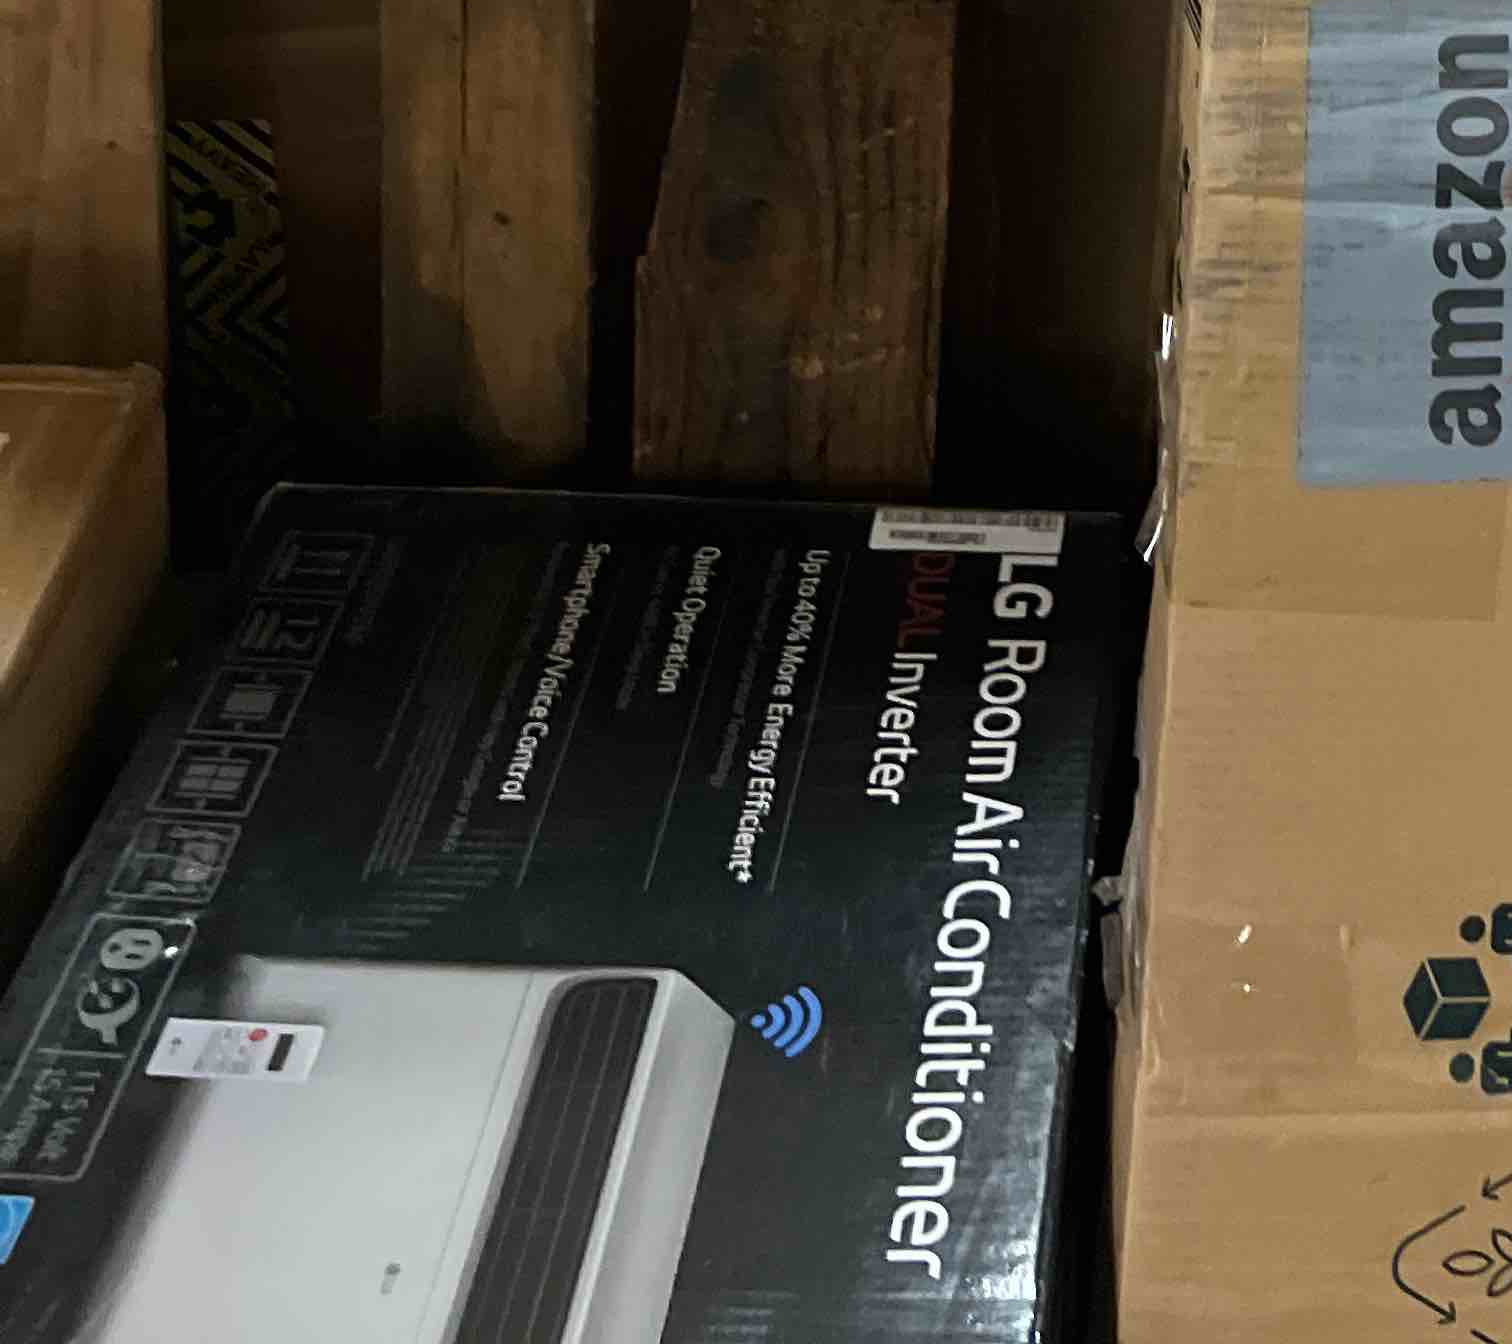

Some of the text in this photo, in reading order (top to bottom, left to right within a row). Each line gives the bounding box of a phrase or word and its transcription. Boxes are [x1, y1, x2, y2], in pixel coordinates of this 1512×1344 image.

[1428, 33, 1510, 448] amazon
[798, 548, 832, 578] Up
[897, 552, 956, 649] DUAL
[528, 543, 612, 720] Smartphone/Voice
[656, 545, 722, 695] Quiet Operation
[787, 602, 817, 641] 40%
[769, 644, 808, 698] More
[497, 721, 550, 802] Control
[747, 703, 795, 775] Energy
[866, 652, 938, 805] Inverter
[886, 554, 1059, 1281] LG Room Air Conditioner
